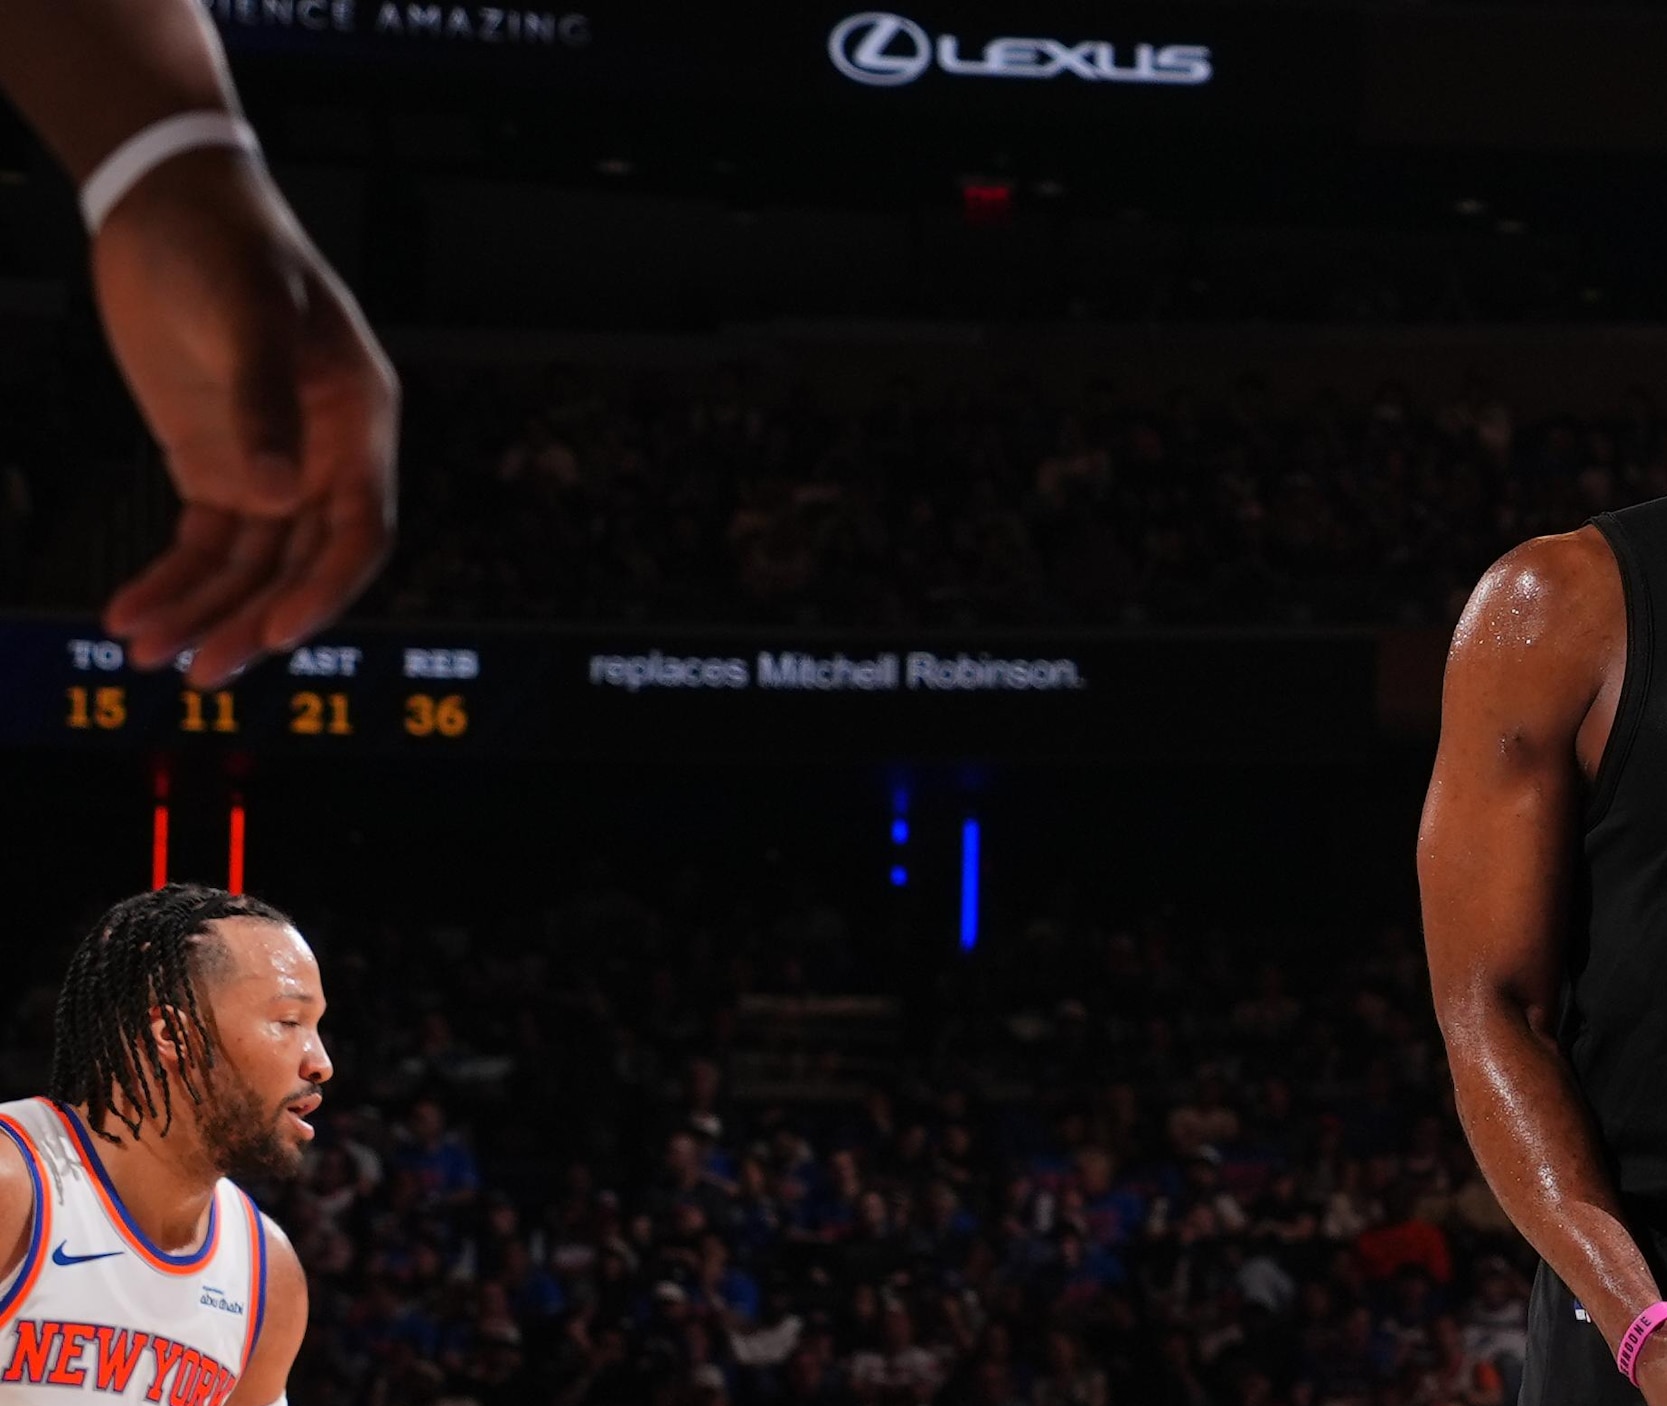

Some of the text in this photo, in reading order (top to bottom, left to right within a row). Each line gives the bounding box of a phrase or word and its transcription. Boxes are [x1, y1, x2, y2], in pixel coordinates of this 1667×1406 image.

[376, 1, 593, 47] AMAZING
[935, 33, 1213, 85] LEXUS
[66, 639, 481, 679] TO AST REB
[588, 650, 1087, 693] replaces Mitchell Robinson.
[65, 685, 470, 738] 15 11 21 36
[2, 1319, 148, 1393] NEW
